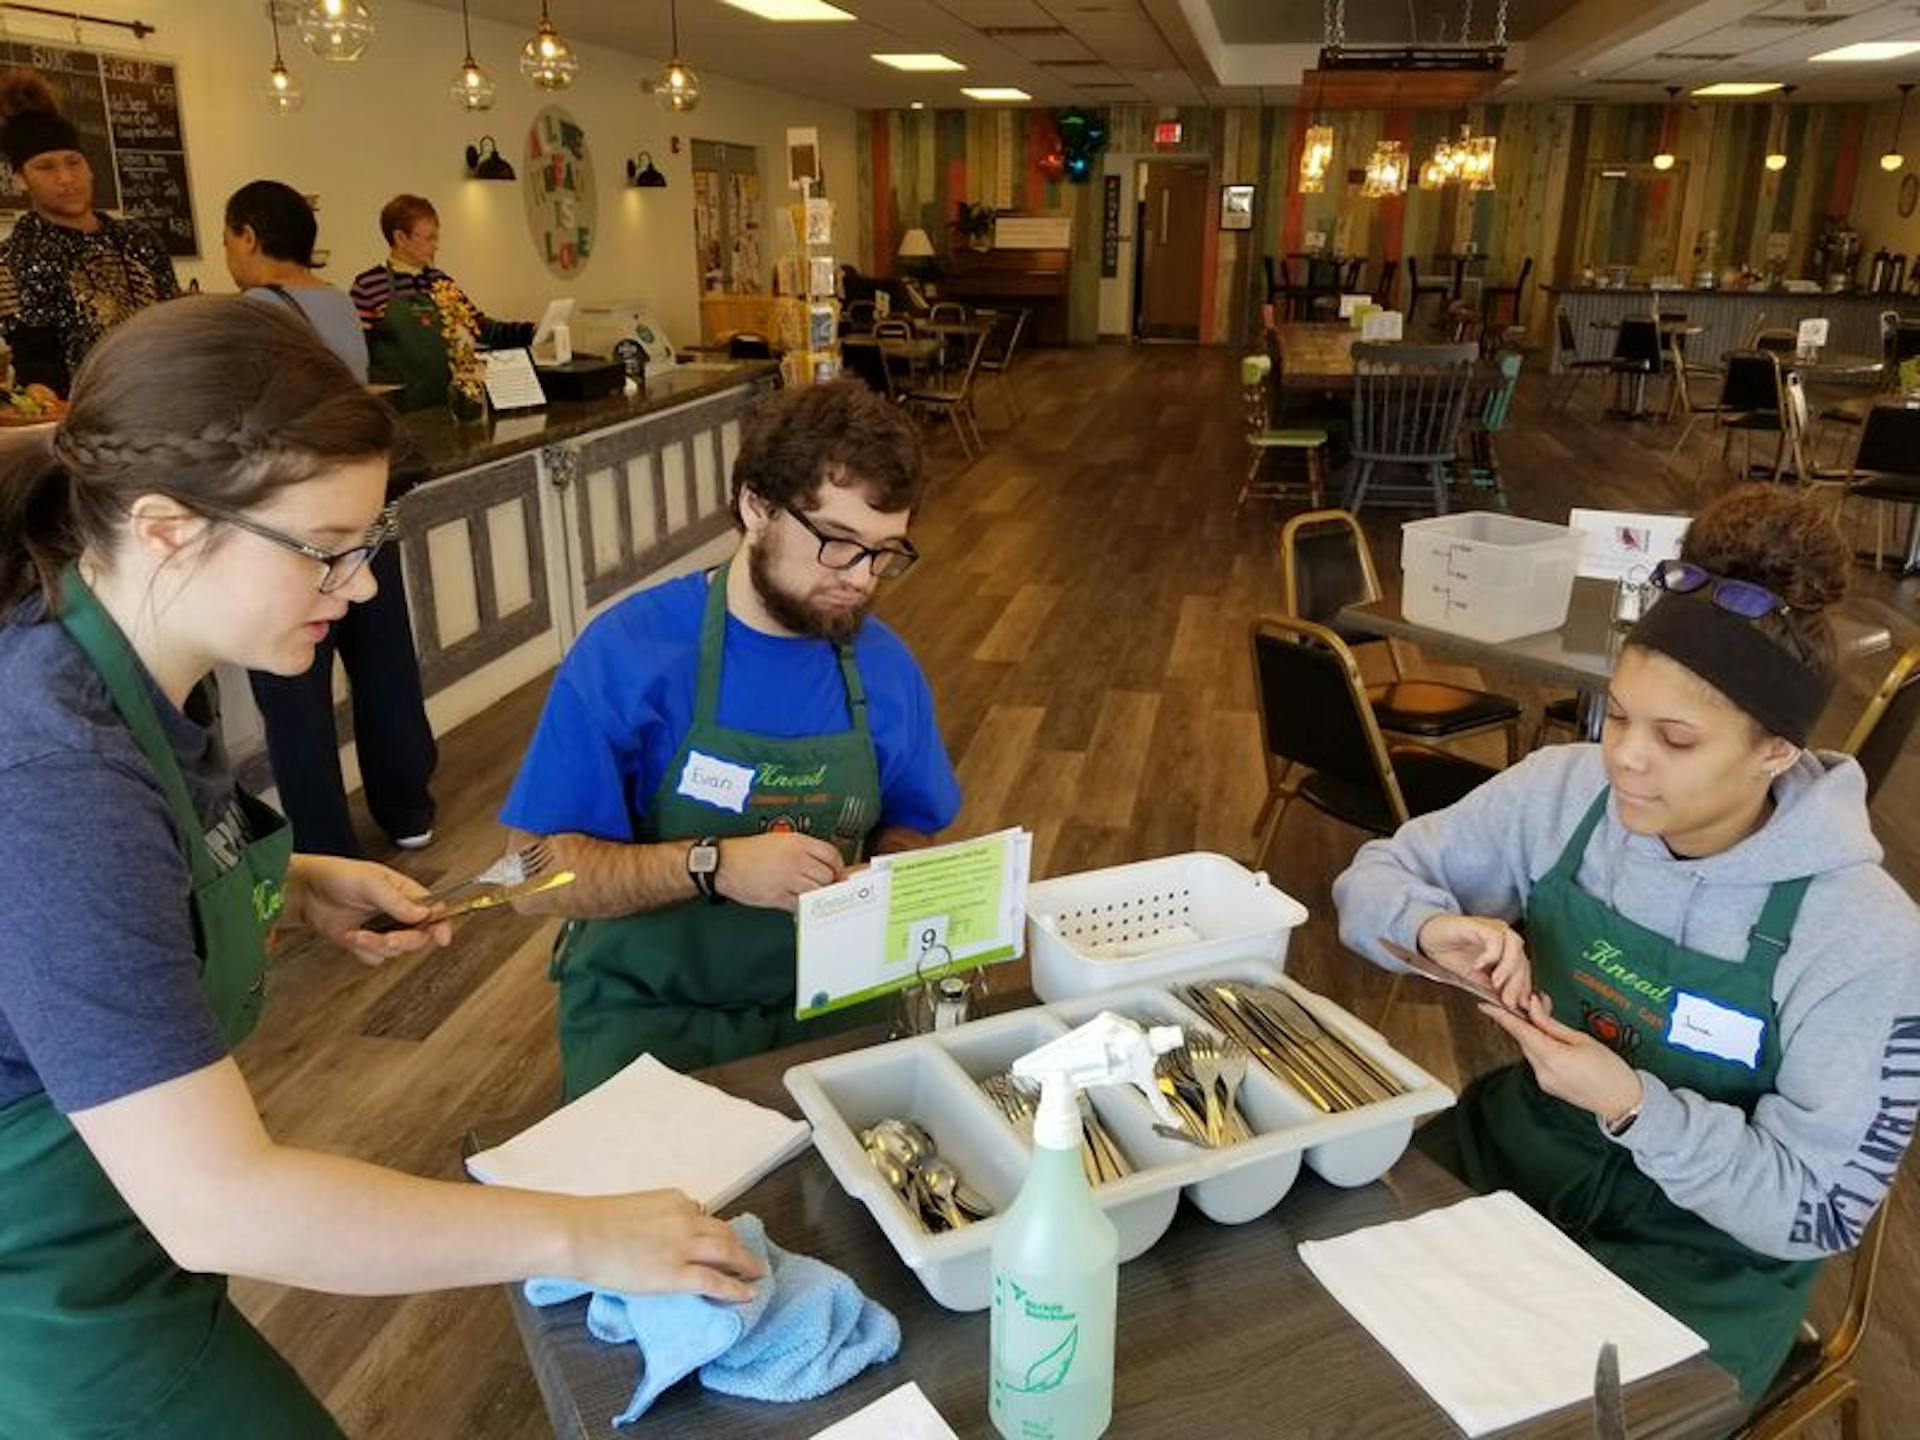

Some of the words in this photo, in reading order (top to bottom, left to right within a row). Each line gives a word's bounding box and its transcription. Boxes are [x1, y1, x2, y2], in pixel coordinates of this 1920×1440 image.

[691, 766, 733, 791] Evan
[757, 763, 827, 787] Knead
[921, 928, 937, 951] 9
[1582, 939, 1673, 1001] Knead
